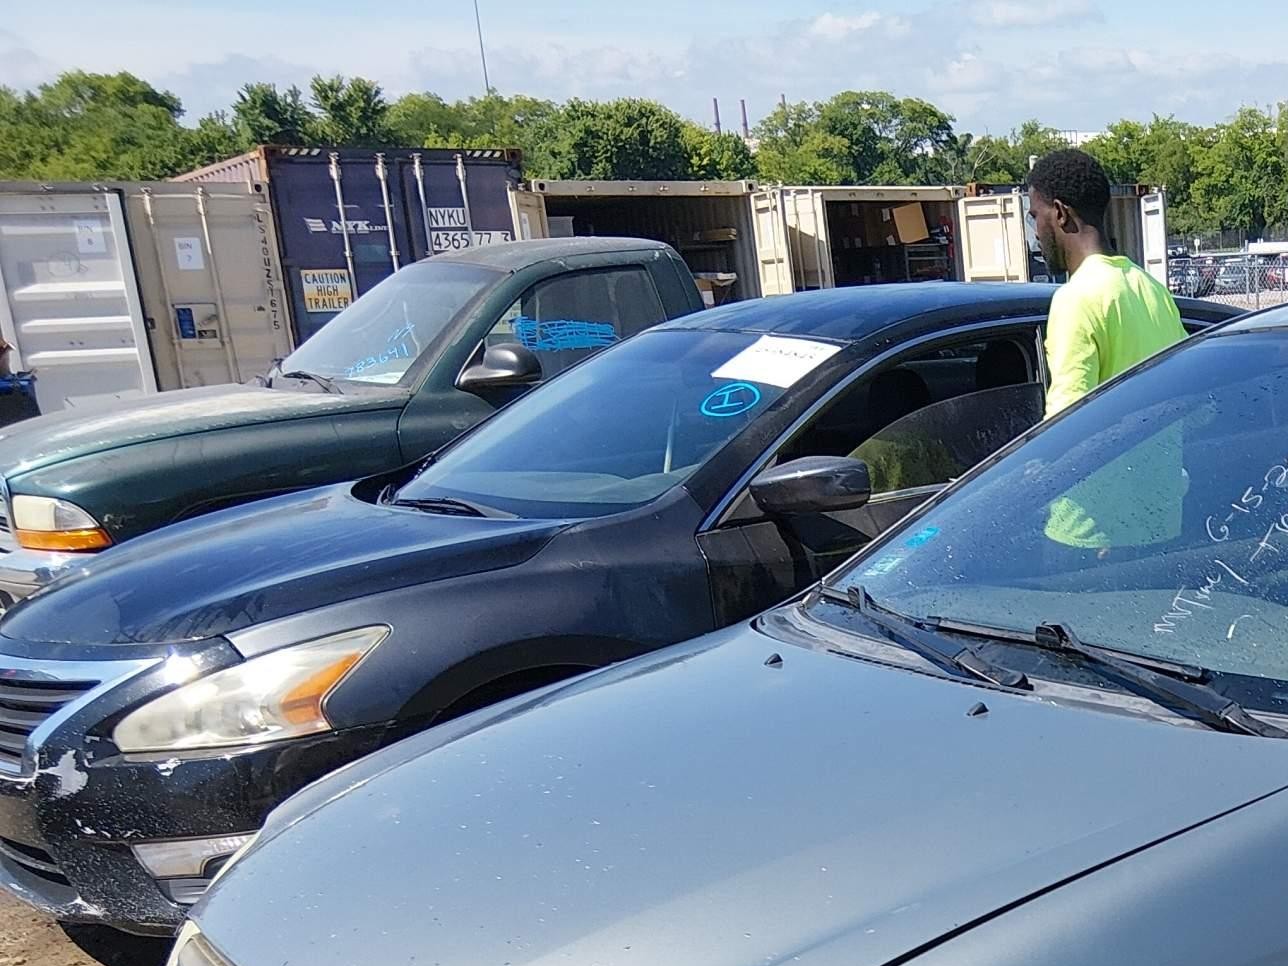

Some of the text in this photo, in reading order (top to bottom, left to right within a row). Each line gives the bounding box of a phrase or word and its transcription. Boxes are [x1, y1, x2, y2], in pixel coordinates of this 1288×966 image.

[428, 208, 467, 226] NYKU
[177, 242, 193, 250] BIN
[304, 273, 347, 285] CAUTION
[316, 285, 339, 297] HIGH
[307, 297, 349, 310] TRAILER
